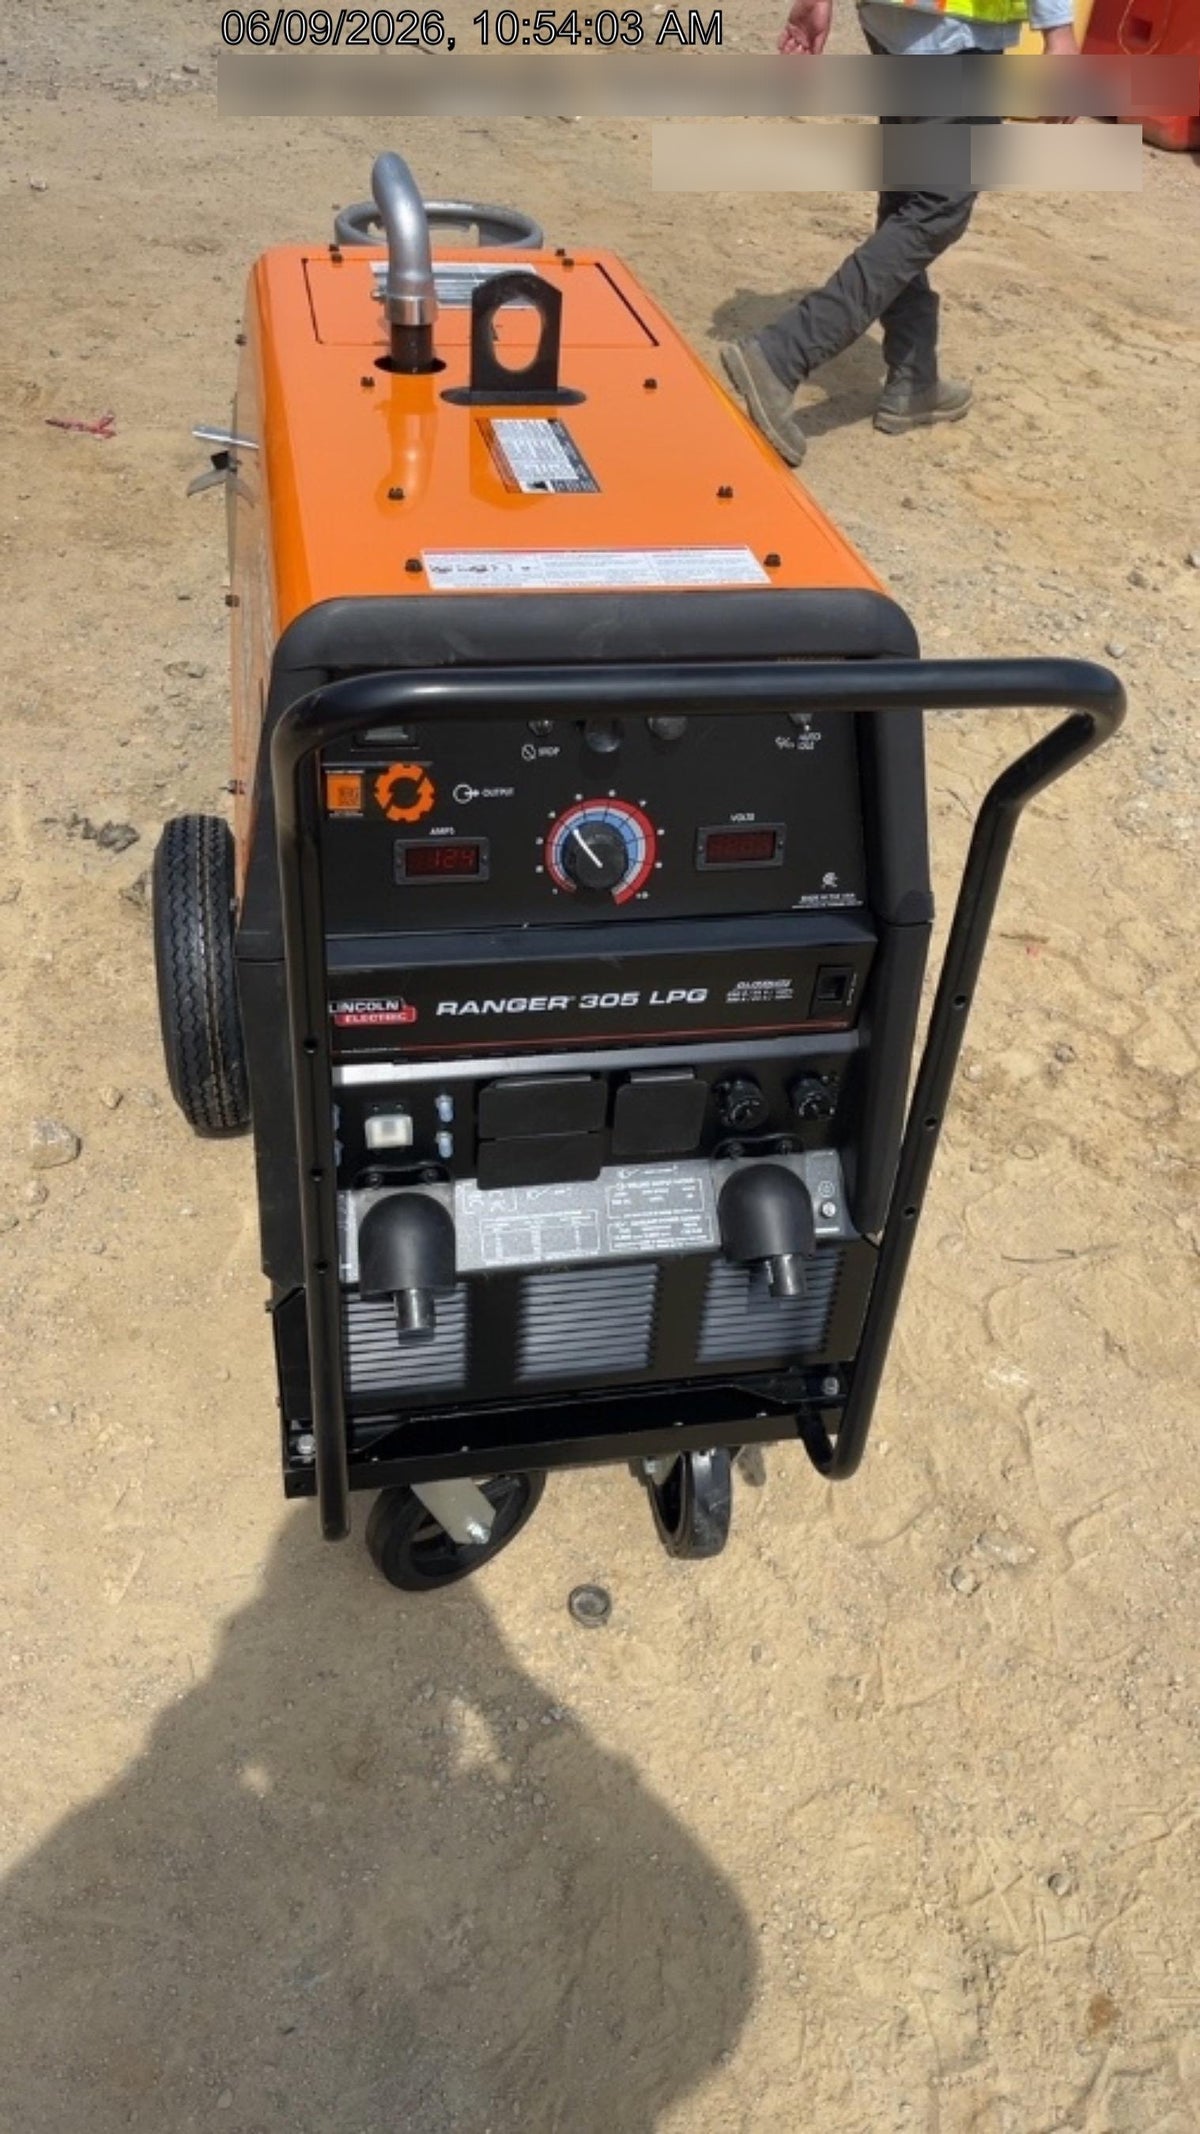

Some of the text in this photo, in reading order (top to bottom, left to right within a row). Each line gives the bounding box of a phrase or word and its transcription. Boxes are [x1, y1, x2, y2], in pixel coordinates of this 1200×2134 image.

[481, 787, 515, 797] OUTPUT
[329, 1000, 399, 1013] LINCOLN
[436, 997, 569, 1016] RANGER
[578, 992, 640, 1009] 305
[649, 988, 709, 1004] LPG
[345, 1013, 407, 1023] ELECTRIC
